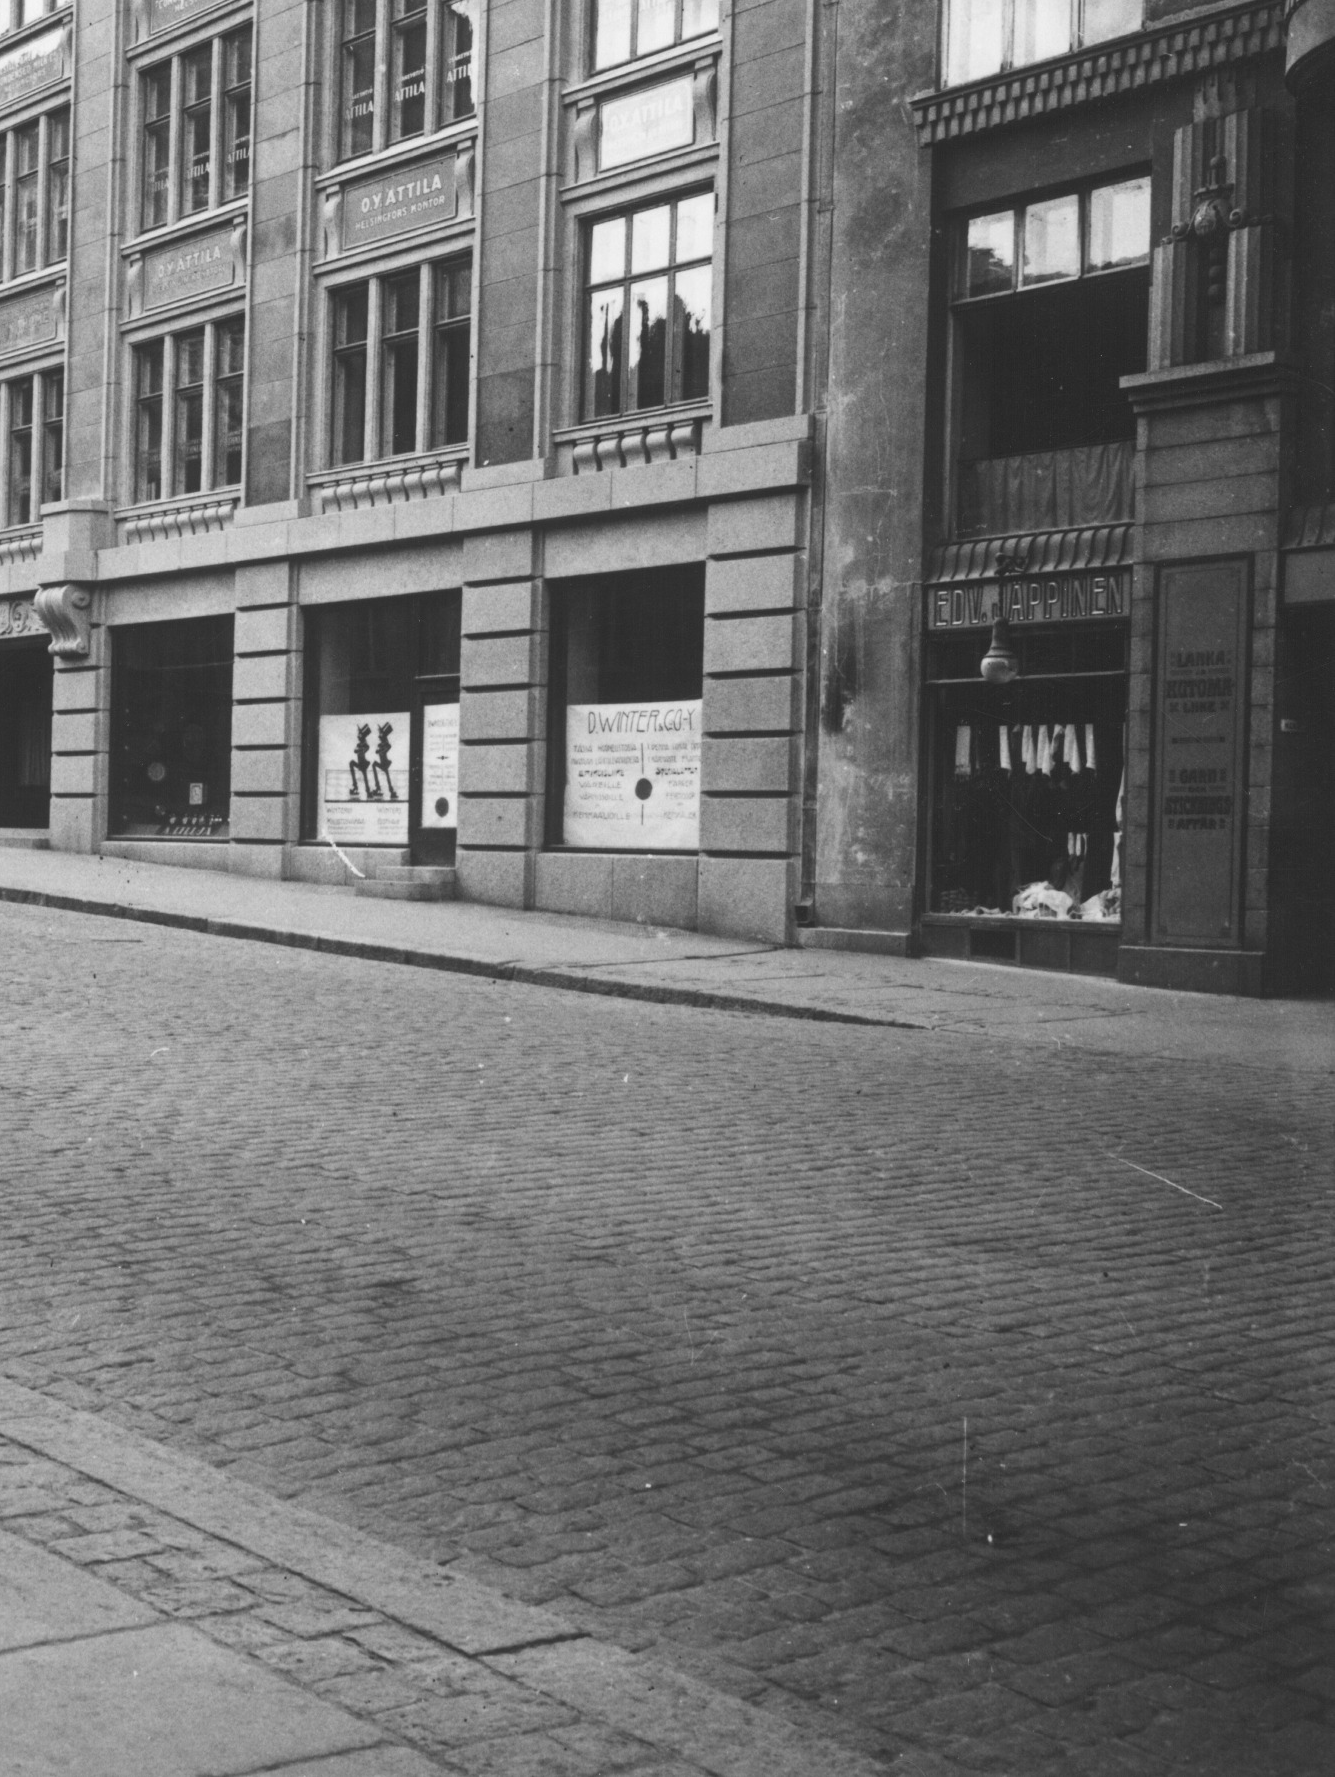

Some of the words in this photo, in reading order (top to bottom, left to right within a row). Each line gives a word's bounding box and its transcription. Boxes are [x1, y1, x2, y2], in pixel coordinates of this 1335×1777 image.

[395, 81, 425, 102] ATTILA
[385, 174, 442, 206] ATTILA
[355, 207, 407, 231] HELSINGFORS
[176, 245, 221, 273] ATTILA
[935, 585, 987, 626] EDV.
[992, 575, 1123, 622] JÄPPINEN
[1176, 650, 1226, 668] LANKA
[1179, 768, 1217, 784] GARN
